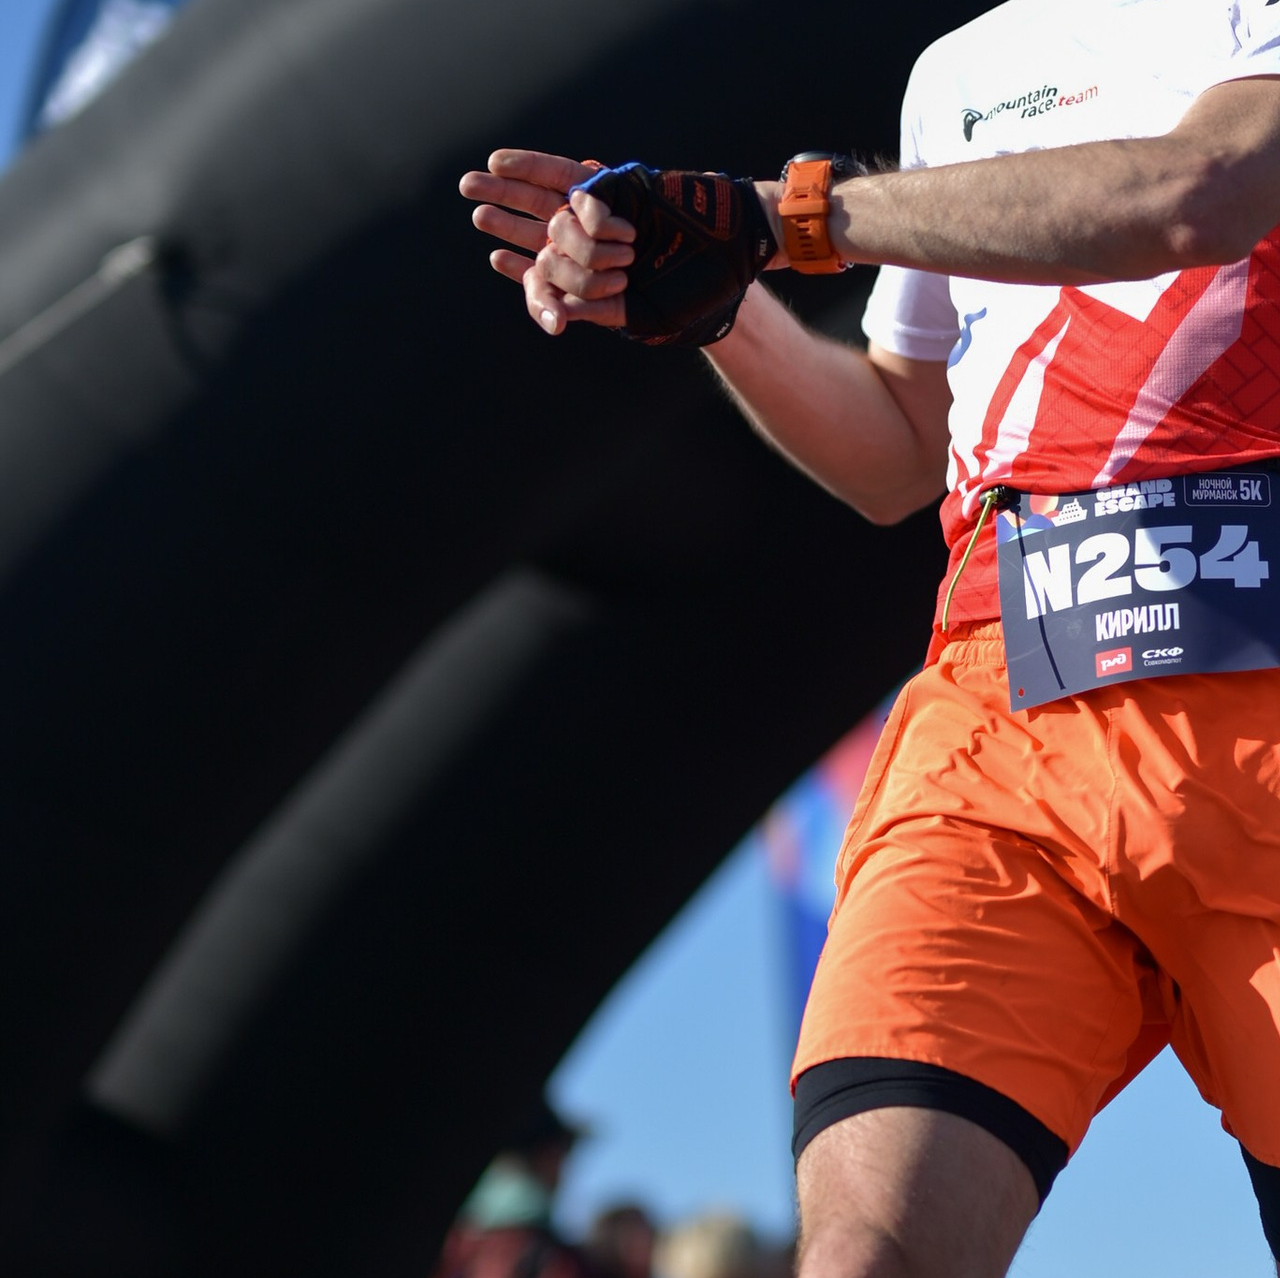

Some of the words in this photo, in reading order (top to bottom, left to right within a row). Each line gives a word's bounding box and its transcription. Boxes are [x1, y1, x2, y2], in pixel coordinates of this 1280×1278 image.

[983, 84, 1058, 121] mountain
[1192, 488, 1238, 501] МУРМАНСК
[1198, 477, 1232, 490] НОЧНОЙ
[1094, 492, 1176, 518] ESCAPE
[1024, 525, 1269, 620] N254
[1095, 603, 1180, 642] КИРИЛЛ
